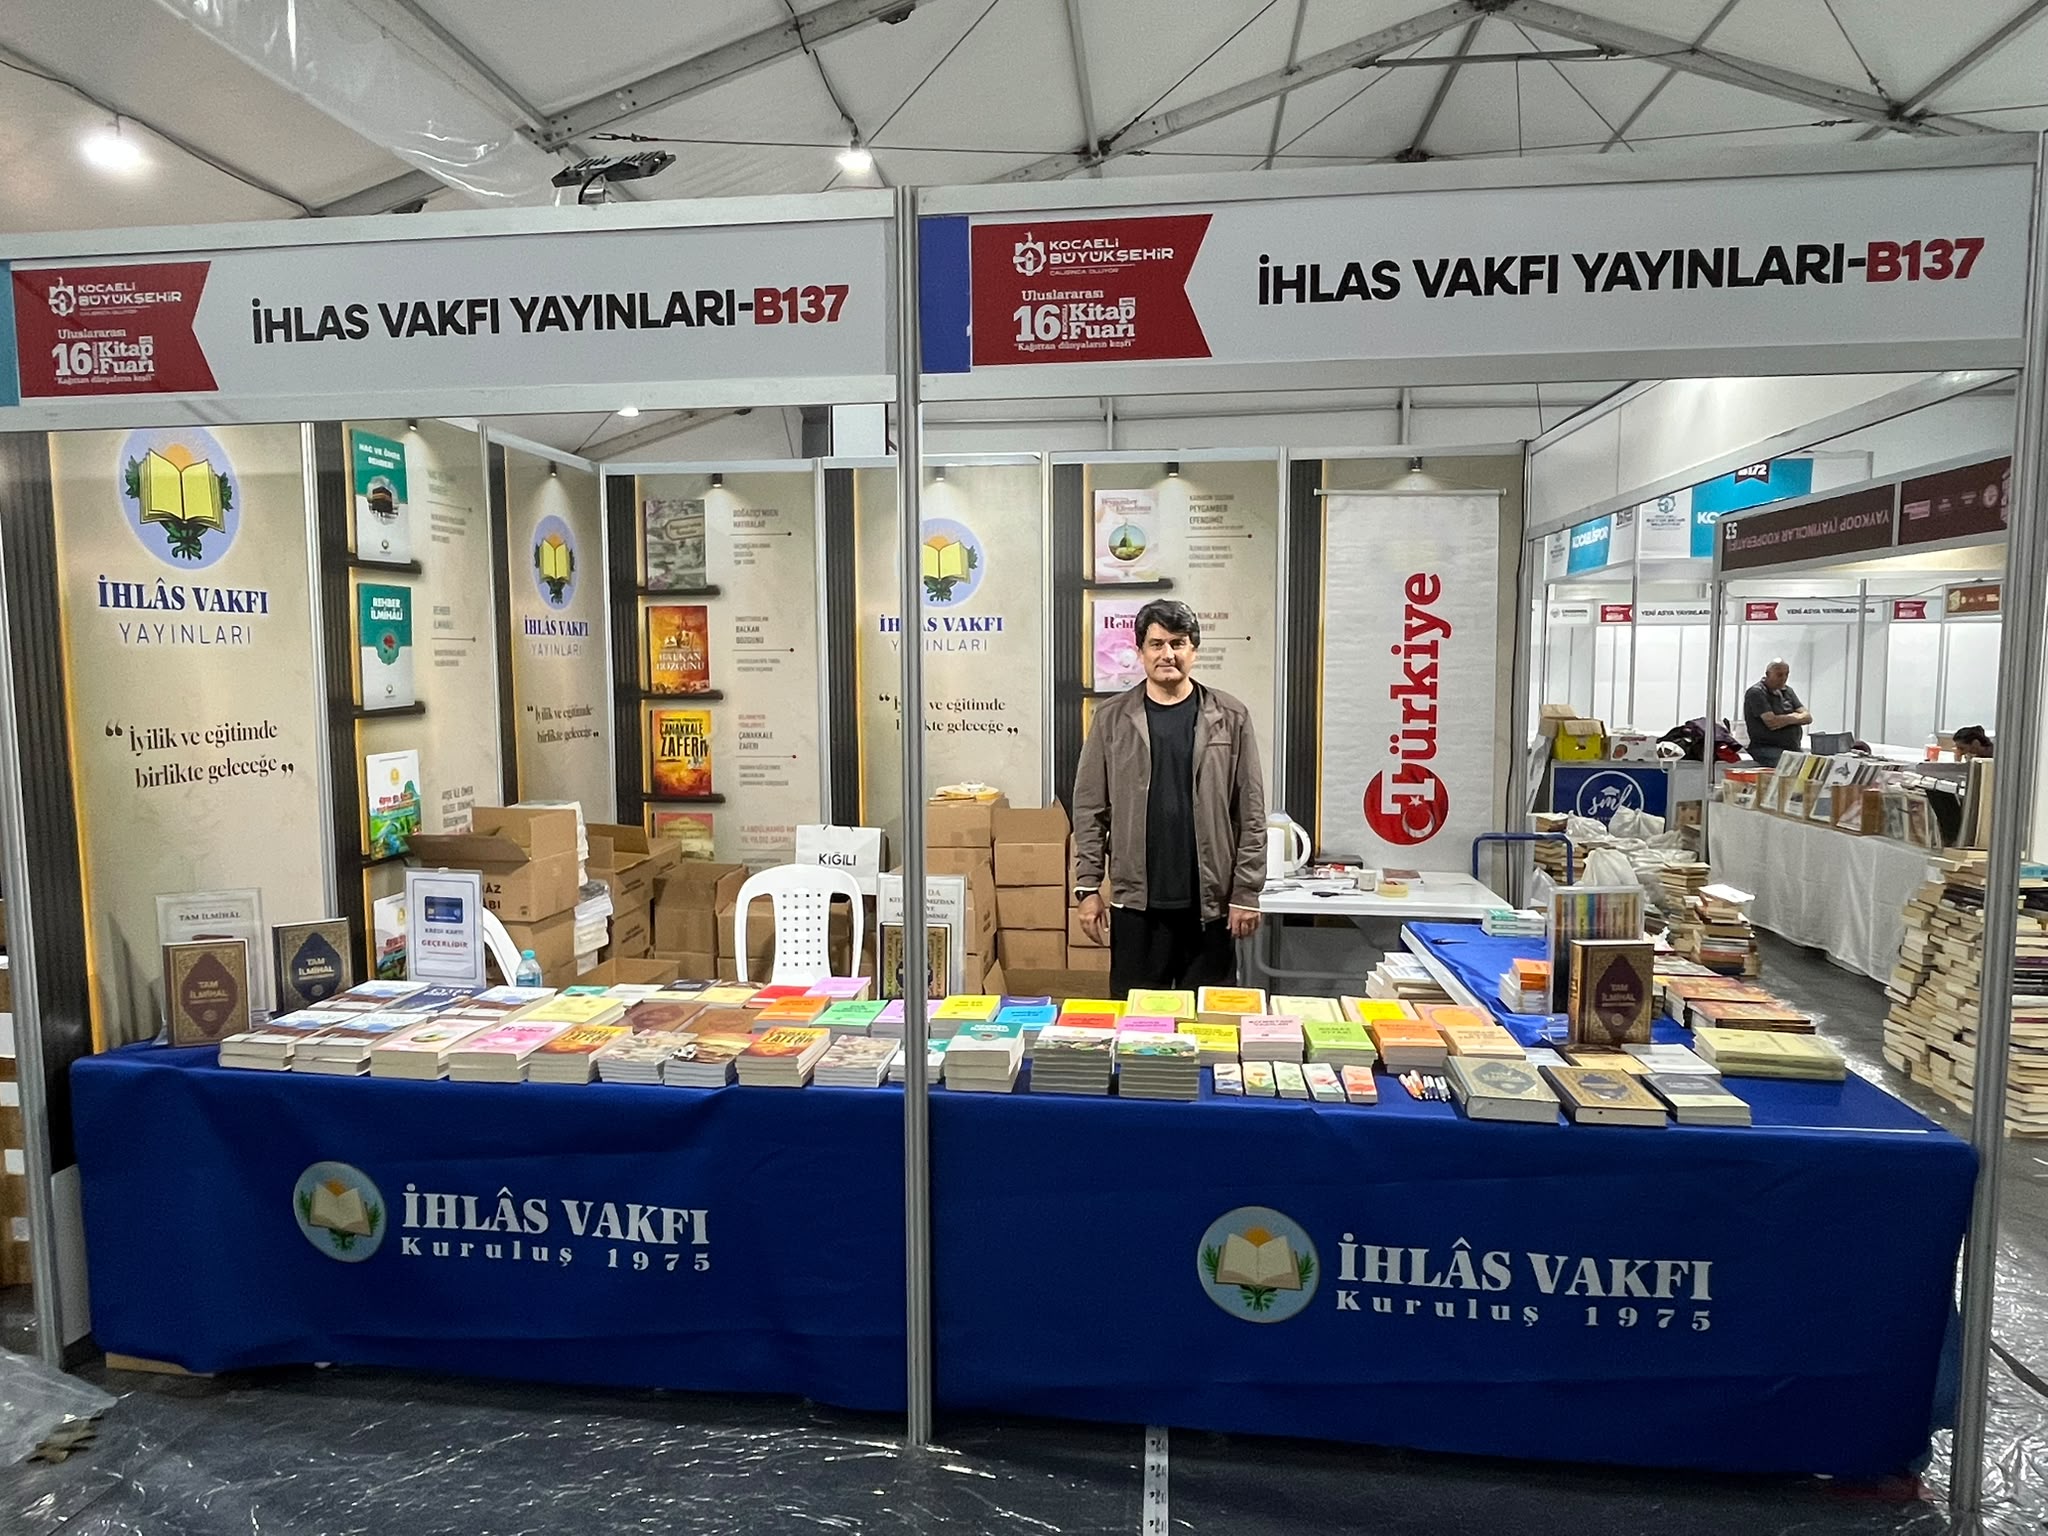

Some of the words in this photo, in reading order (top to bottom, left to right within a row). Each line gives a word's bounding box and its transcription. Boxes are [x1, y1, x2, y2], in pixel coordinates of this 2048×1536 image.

[1049, 248, 1174, 265] BÜYÜKŞEHİR
[1257, 254, 1401, 305] İHLAS
[1411, 255, 1560, 299] VAKFI
[1572, 237, 1986, 293] YAYINLARI-B137
[1021, 289, 1104, 301] Uluslararası
[251, 296, 370, 344] İHLAS
[377, 297, 501, 339] VAKFI
[509, 284, 850, 334] YAYINLARI-B137
[1069, 303, 1136, 324] Kitap
[1069, 321, 1136, 339] Fuarı
[99, 340, 154, 360] Kitap
[100, 359, 155, 375] Fuarı
[1839, 509, 1890, 531] YAYKOOP
[98, 575, 186, 613] İHLÂS
[193, 588, 269, 615] VAKFI
[118, 621, 252, 645] YAYINLARI
[524, 614, 559, 636] İHLÂS
[560, 620, 589, 637] VAKFI
[880, 614, 938, 632] İHS
[943, 617, 1003, 632] VAKFI
[530, 643, 582, 657] YAYINLARI
[891, 639, 988, 651] YINLARI
[1380, 571, 1452, 815] Türkiye
[929, 701, 943, 711] ve
[946, 697, 1006, 714] eğitimde
[180, 733, 201, 748] ve
[204, 720, 278, 749] eğitimde
[659, 722, 704, 737] ÇANAKKALE
[738, 731, 773, 741] ÇANAKKALE
[135, 757, 204, 789] birlikte
[179, 914, 200, 922] TAM
[305, 957, 325, 966] TAM
[199, 980, 218, 989] TAM
[402, 1183, 549, 1235] İHLÂS
[561, 1199, 711, 1245] VAKFI
[401, 1237, 573, 1267] Kuruluş
[607, 1248, 711, 1271] 1975
[1337, 1232, 1511, 1292] İHLÂS
[1526, 1251, 1714, 1301] VAKFI
[1336, 1290, 1540, 1328] Kuruluş
[1584, 1305, 1711, 1332] 1975
